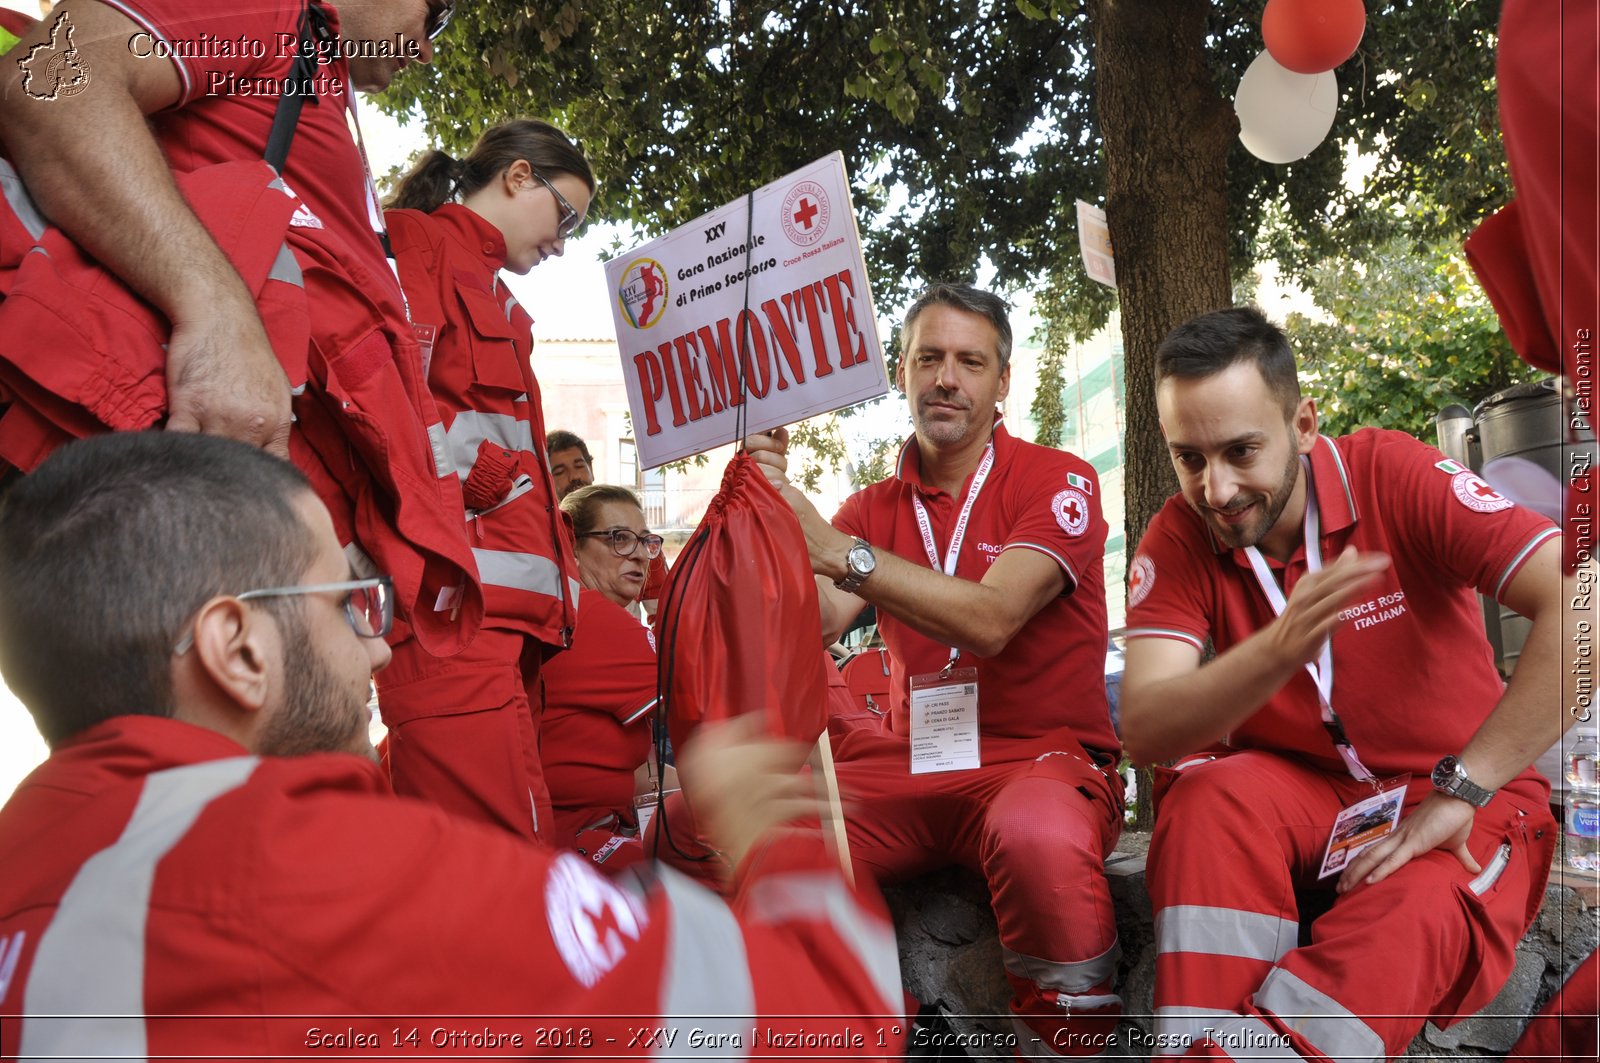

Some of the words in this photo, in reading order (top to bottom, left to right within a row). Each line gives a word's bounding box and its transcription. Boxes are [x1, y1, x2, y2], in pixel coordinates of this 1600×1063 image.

[704, 221, 727, 244] XXV
[782, 255, 802, 268] Croce
[802, 246, 822, 260] Rossa
[821, 237, 846, 250] Italiana
[675, 292, 689, 308] di
[690, 279, 723, 304] Primo
[724, 256, 778, 288] Soccorso
[677, 260, 705, 282] Gara
[633, 268, 869, 437] PIEMONTE
[970, 480, 982, 495] XXV
[917, 511, 925, 520] 13
[919, 520, 932, 549] OTTOBRE
[950, 514, 967, 555] NAZIONALE
[929, 549, 937, 566] 2018
[1338, 600, 1377, 621] CROCE
[1354, 604, 1407, 631] ITALIANA
